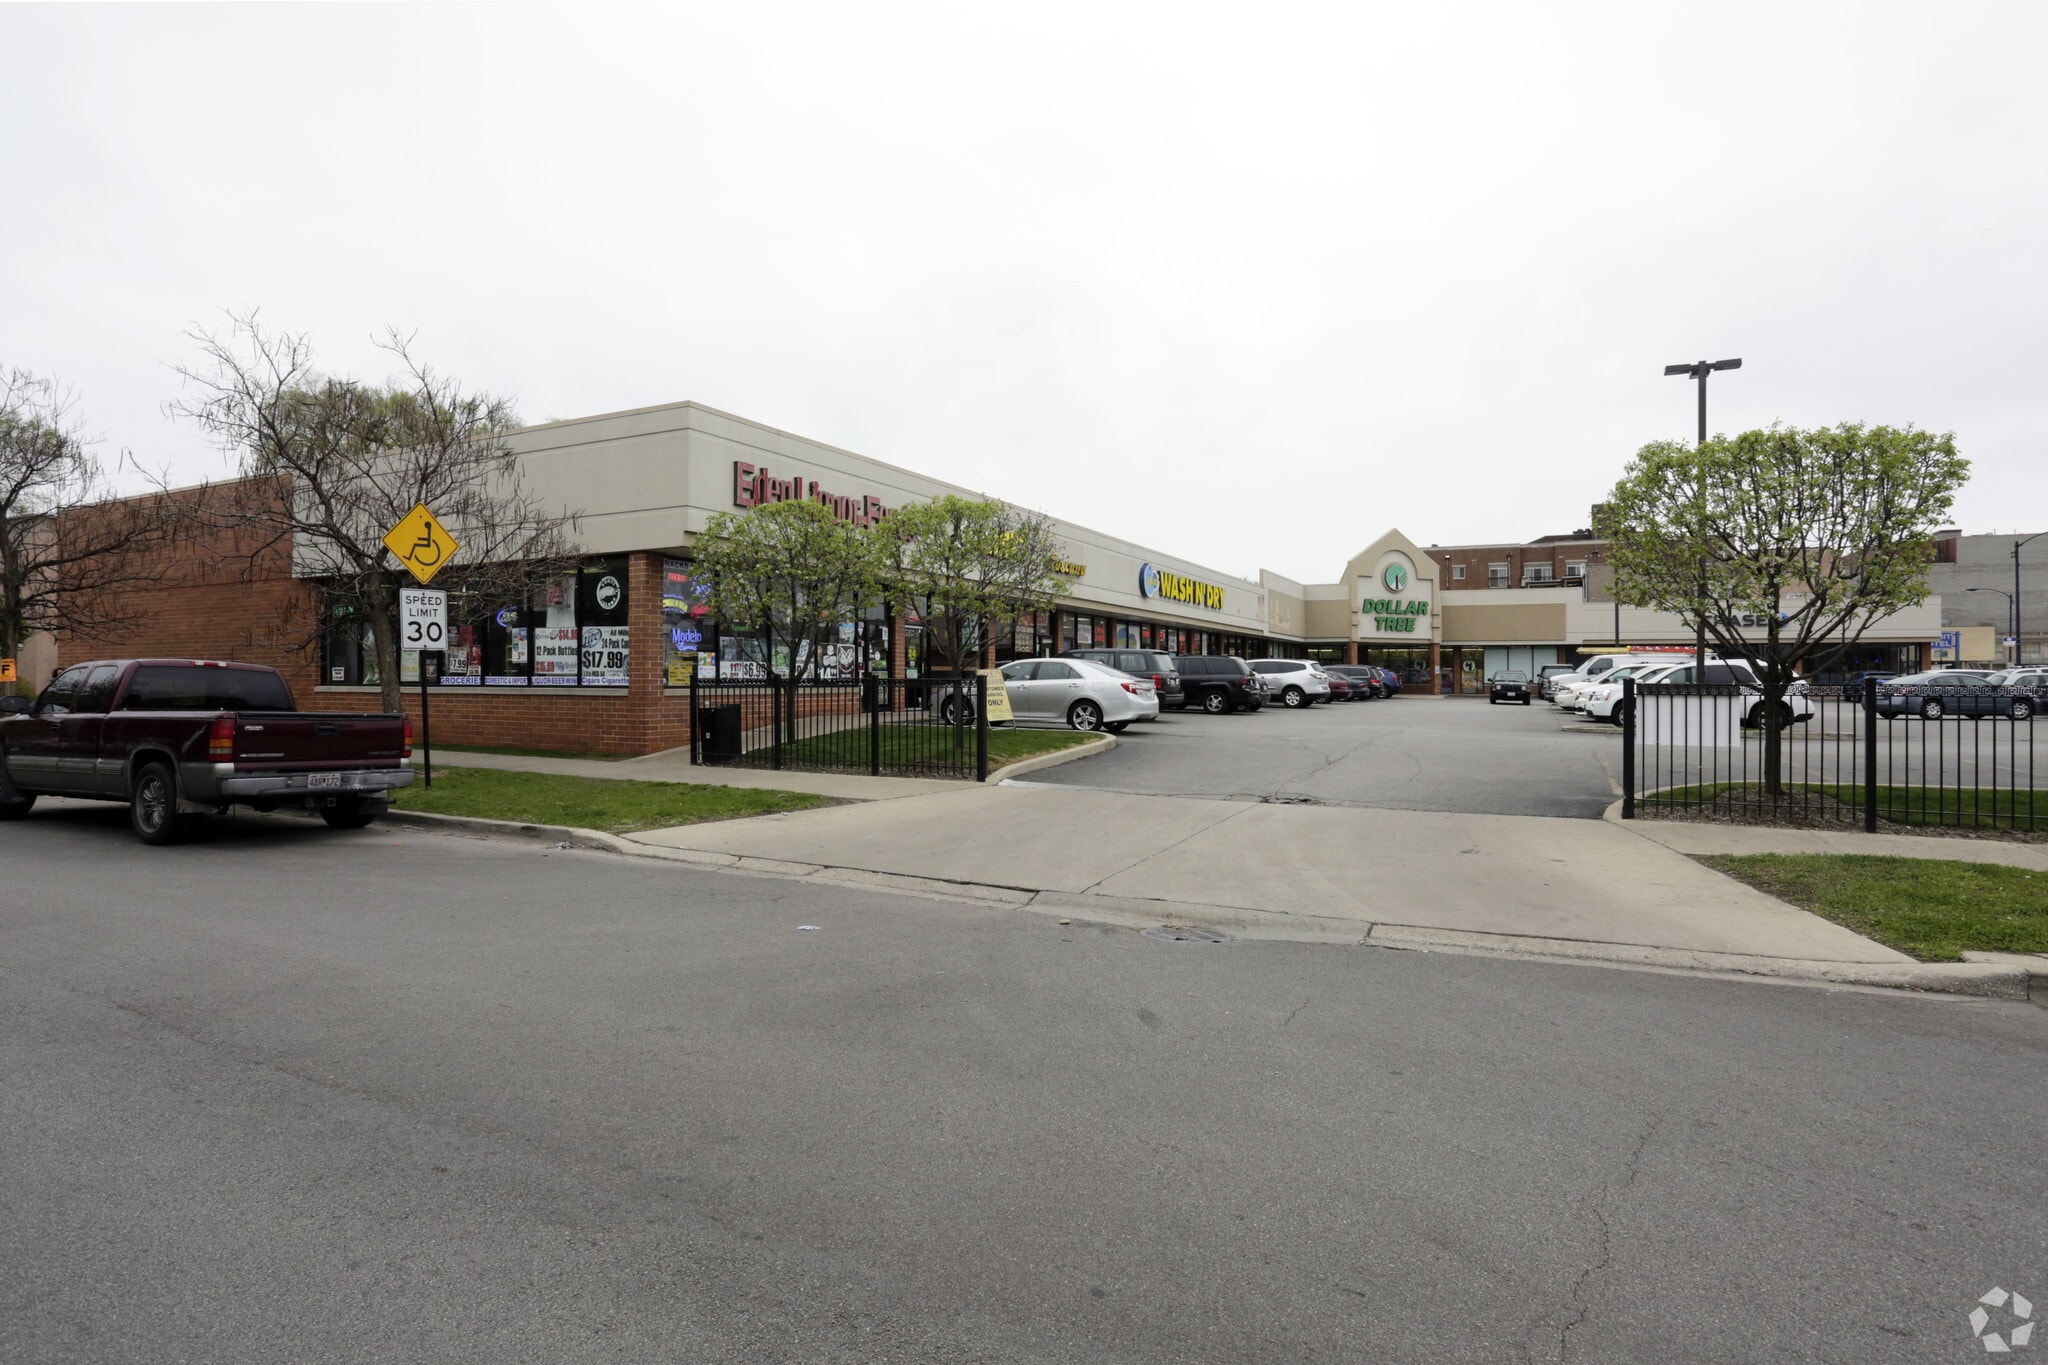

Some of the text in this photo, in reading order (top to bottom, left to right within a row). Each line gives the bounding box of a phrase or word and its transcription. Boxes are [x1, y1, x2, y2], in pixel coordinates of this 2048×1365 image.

[734, 461, 793, 507] Eden
[664, 560, 689, 569] NACKS
[1158, 570, 1194, 603] WASH
[1207, 584, 1226, 609] DRY
[405, 595, 442, 606] SPEED
[1362, 598, 1429, 616] DOLLAR
[409, 608, 438, 618] LIMIT
[1374, 616, 1417, 632] TREE
[406, 621, 442, 642] 30
[672, 627, 702, 643] Modelo
[609, 638, 620, 649] Pack
[536, 646, 542, 656] 12
[543, 646, 556, 656] Pack
[582, 650, 623, 669] $17.99
[440, 676, 480, 685] GROCERIE
[581, 677, 600, 685] Cigars
